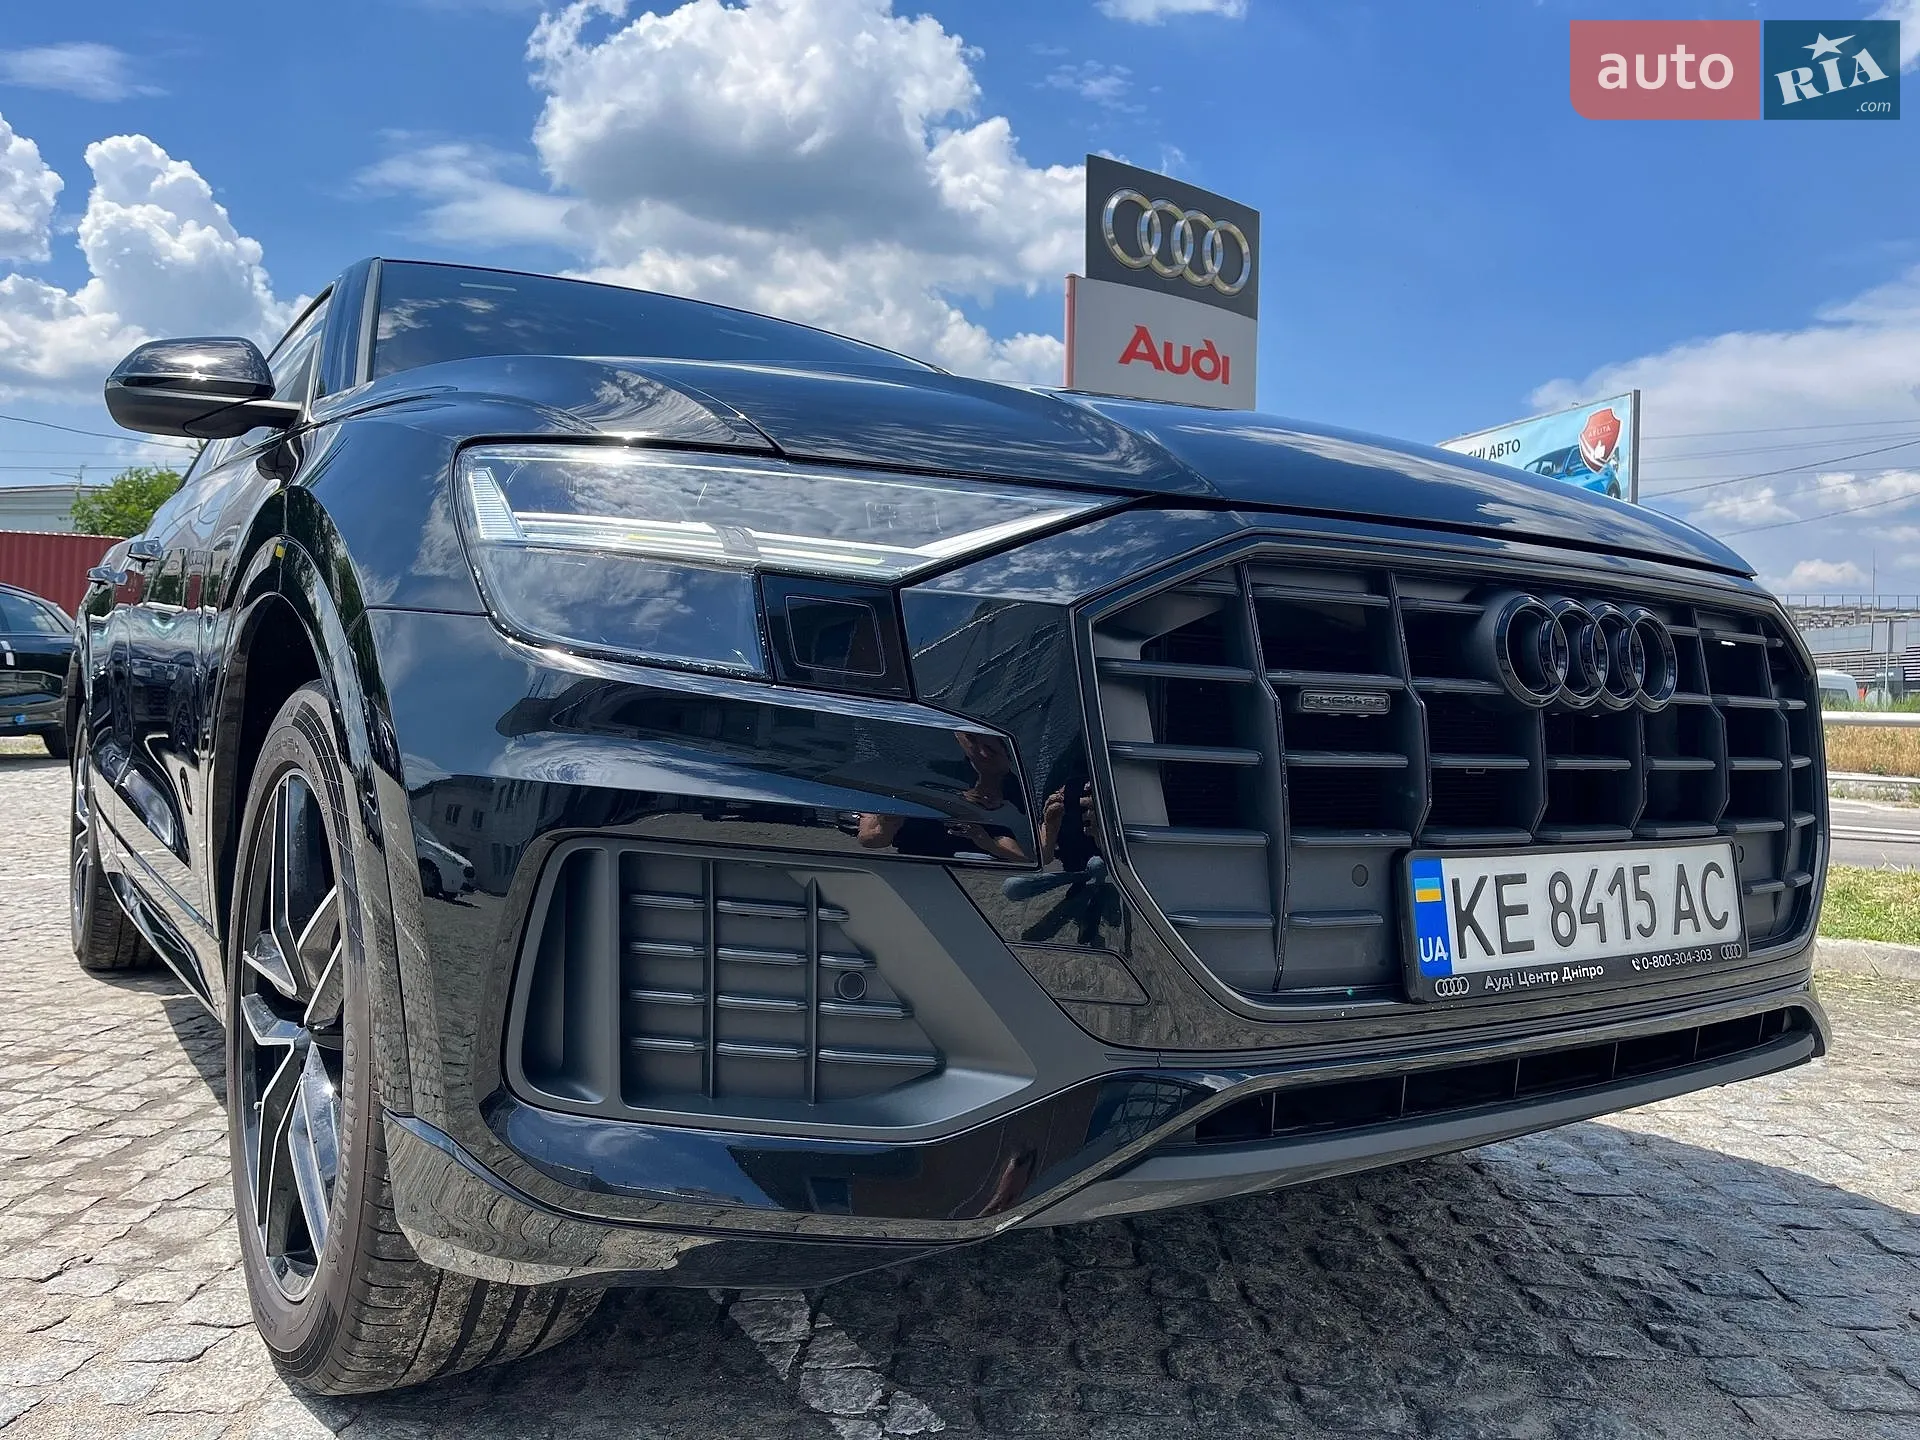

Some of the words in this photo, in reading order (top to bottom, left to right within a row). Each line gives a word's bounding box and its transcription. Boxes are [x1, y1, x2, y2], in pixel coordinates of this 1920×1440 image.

[1118, 324, 1230, 385] Audi
[1488, 438, 1521, 461] АВТО
[1451, 872, 1536, 960] KE
[1548, 864, 1658, 948] 8415
[1673, 860, 1730, 936] AC
[1418, 935, 1447, 963] UA
[1641, 948, 1713, 970] 0-800-304-303
[1484, 972, 1515, 992] Ауді
[1516, 970, 1559, 987] Центр
[1561, 964, 1604, 983] Дніпро
